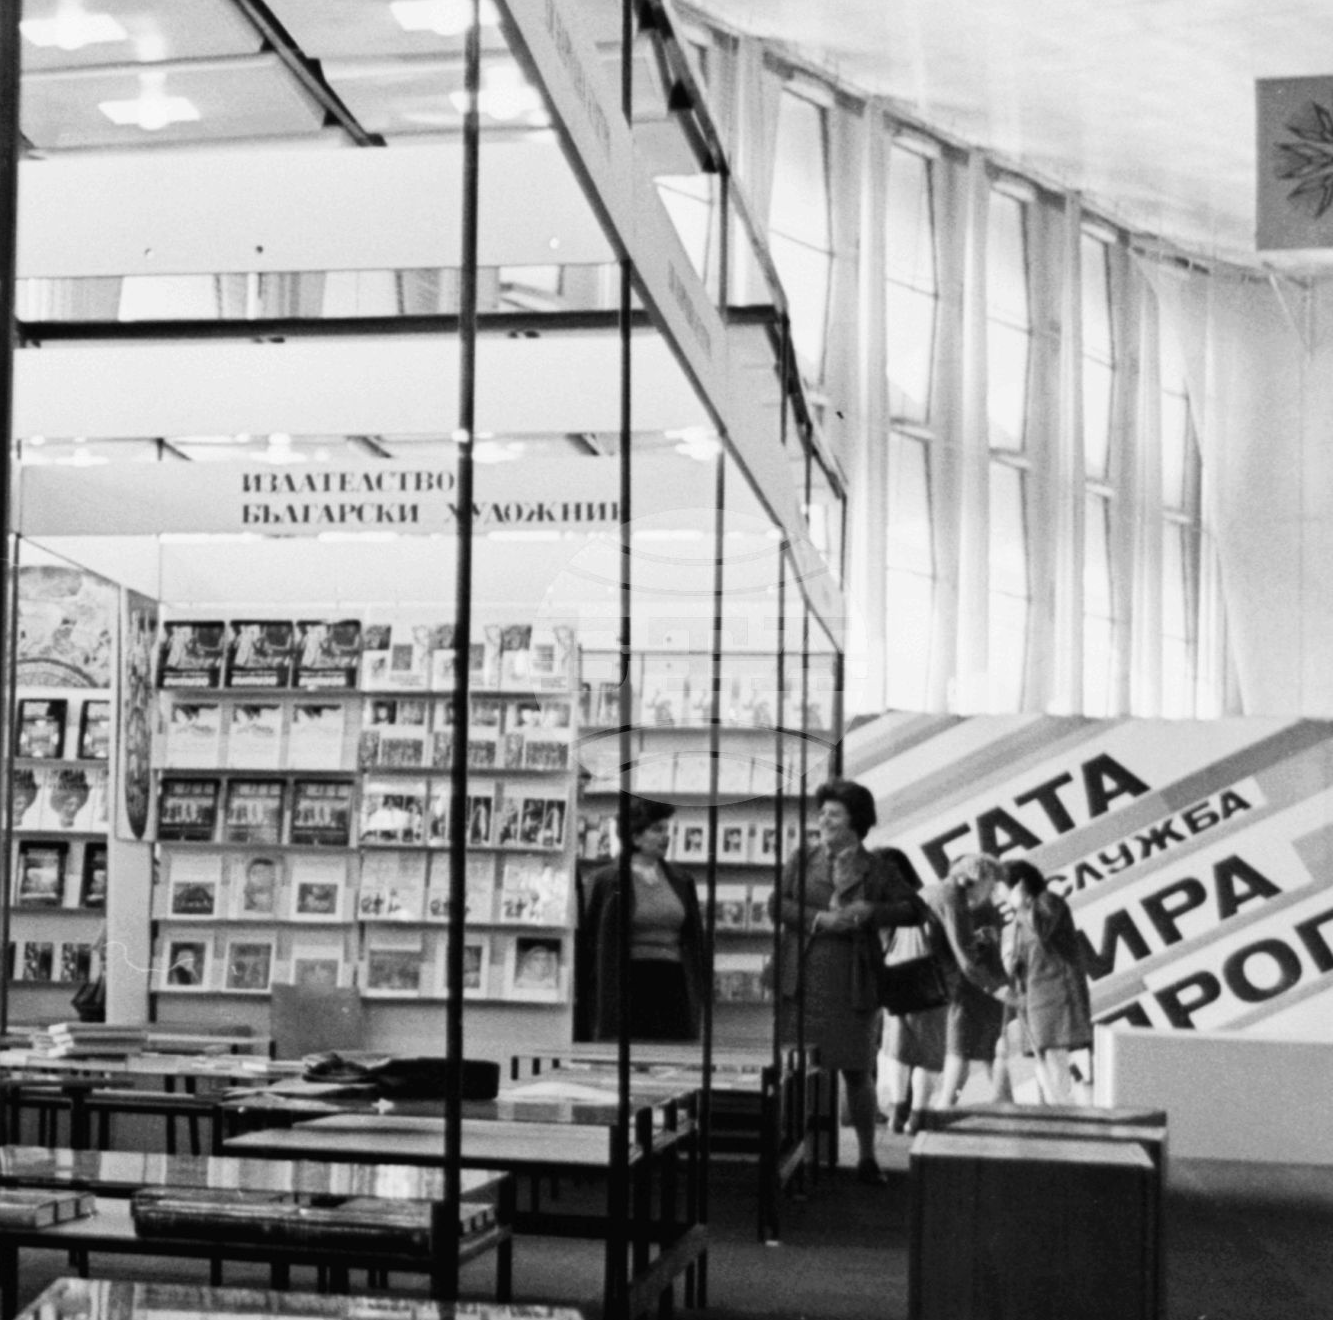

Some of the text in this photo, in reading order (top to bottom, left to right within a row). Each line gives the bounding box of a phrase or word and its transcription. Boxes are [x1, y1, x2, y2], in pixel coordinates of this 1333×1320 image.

[242, 471, 455, 493] ИЗДАТЕЛСТВО
[242, 503, 419, 524] БЪЛГАРСКИ
[1044, 790, 1252, 898] СЛУЖБА
